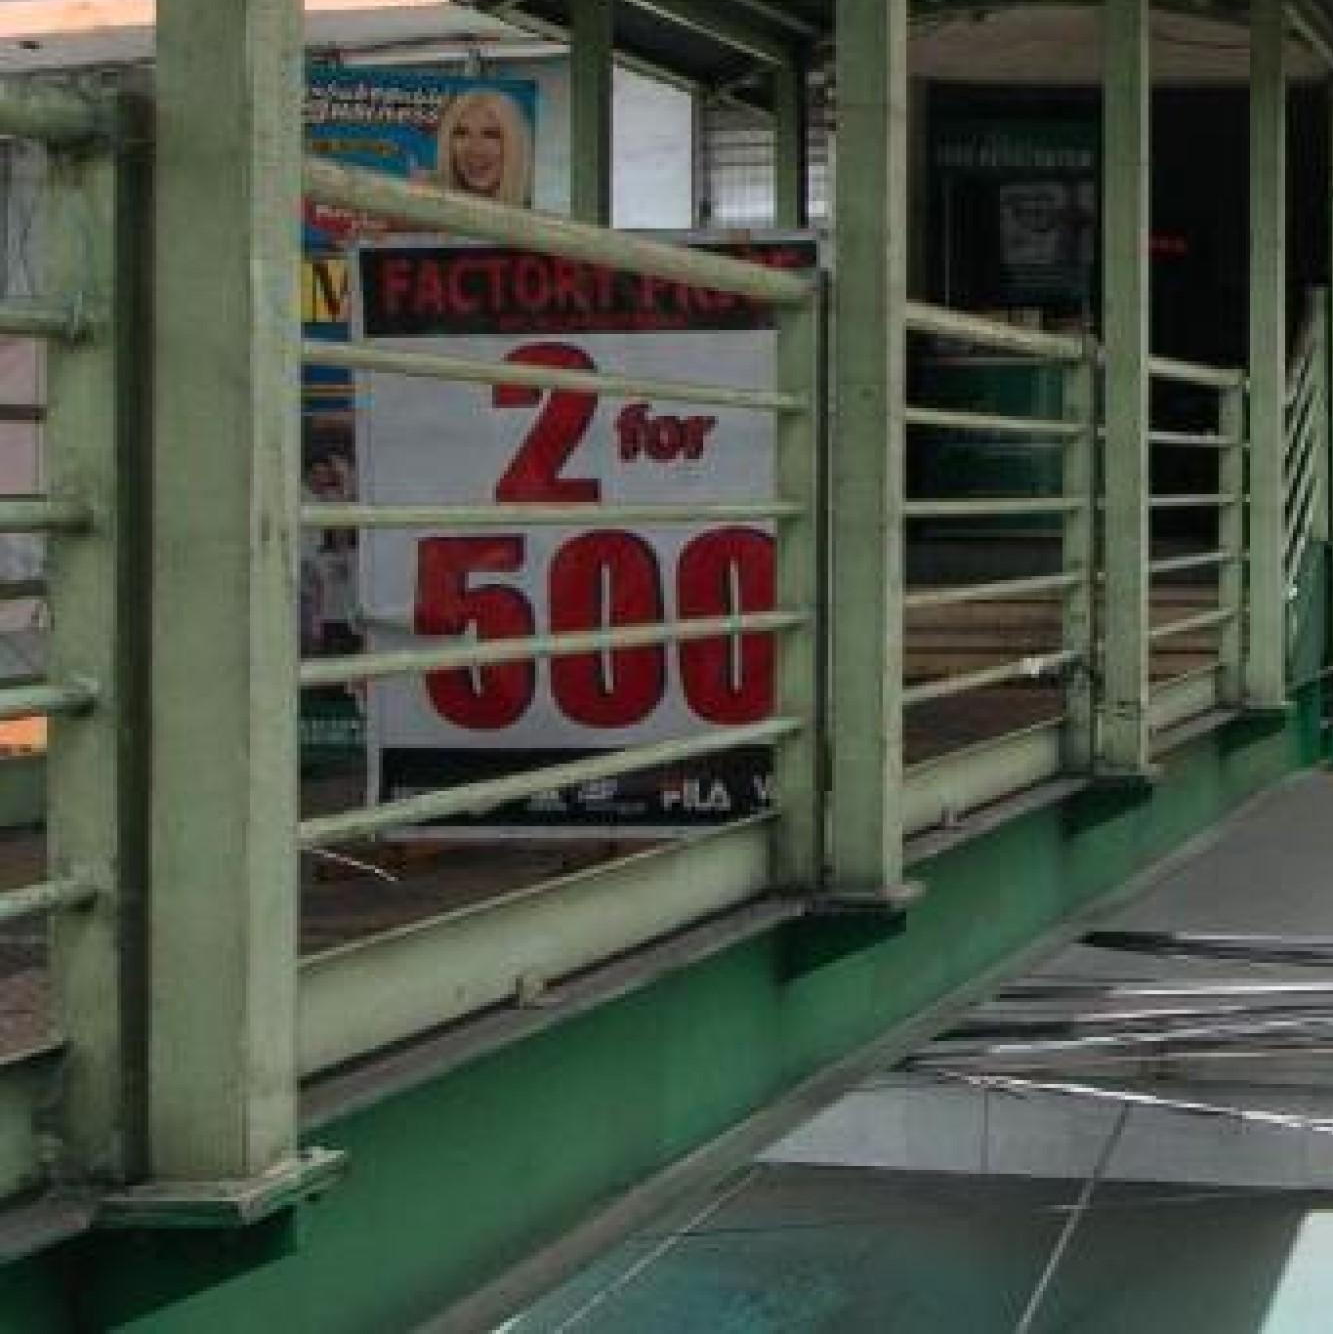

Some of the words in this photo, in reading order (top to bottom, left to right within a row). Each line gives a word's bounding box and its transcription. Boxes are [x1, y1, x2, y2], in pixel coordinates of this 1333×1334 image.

[492, 342, 599, 503] 2
[616, 402, 716, 463] for
[414, 524, 777, 732] 500
